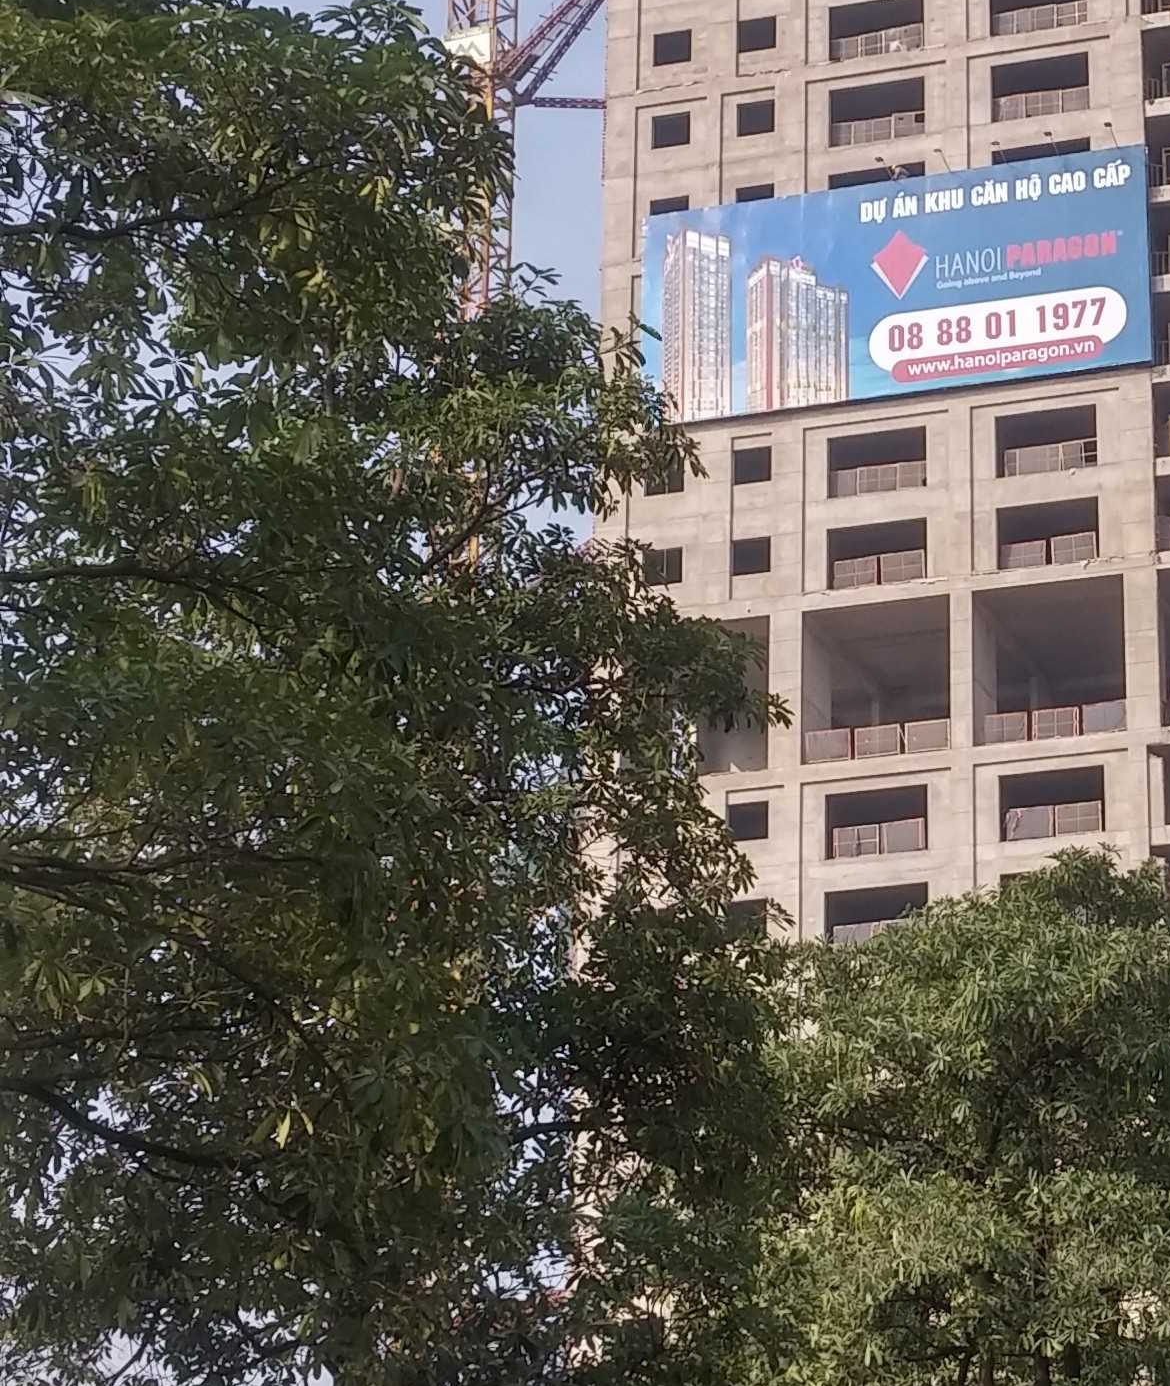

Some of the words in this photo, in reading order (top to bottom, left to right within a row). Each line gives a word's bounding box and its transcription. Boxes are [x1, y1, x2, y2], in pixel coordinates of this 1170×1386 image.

[860, 196, 888, 224] DỰ
[892, 191, 918, 219] ÁN
[924, 187, 965, 213] KHU
[970, 180, 1009, 207] CĂN
[1015, 176, 1042, 201] HỘ
[1048, 171, 1087, 196] CAO
[1093, 159, 1132, 189] CẤP
[935, 246, 1001, 279] HANOI
[1006, 230, 1118, 269] PARAGON
[936, 279, 964, 293] Going
[963, 275, 990, 287] above
[991, 271, 1008, 283] and
[1008, 267, 1042, 282] Beyond
[888, 322, 924, 353] 08
[936, 315, 972, 346] 88
[985, 309, 1017, 340] 01
[1035, 296, 1107, 334] 1977
[906, 338, 1095, 377] www.hanoiparagon.vn
